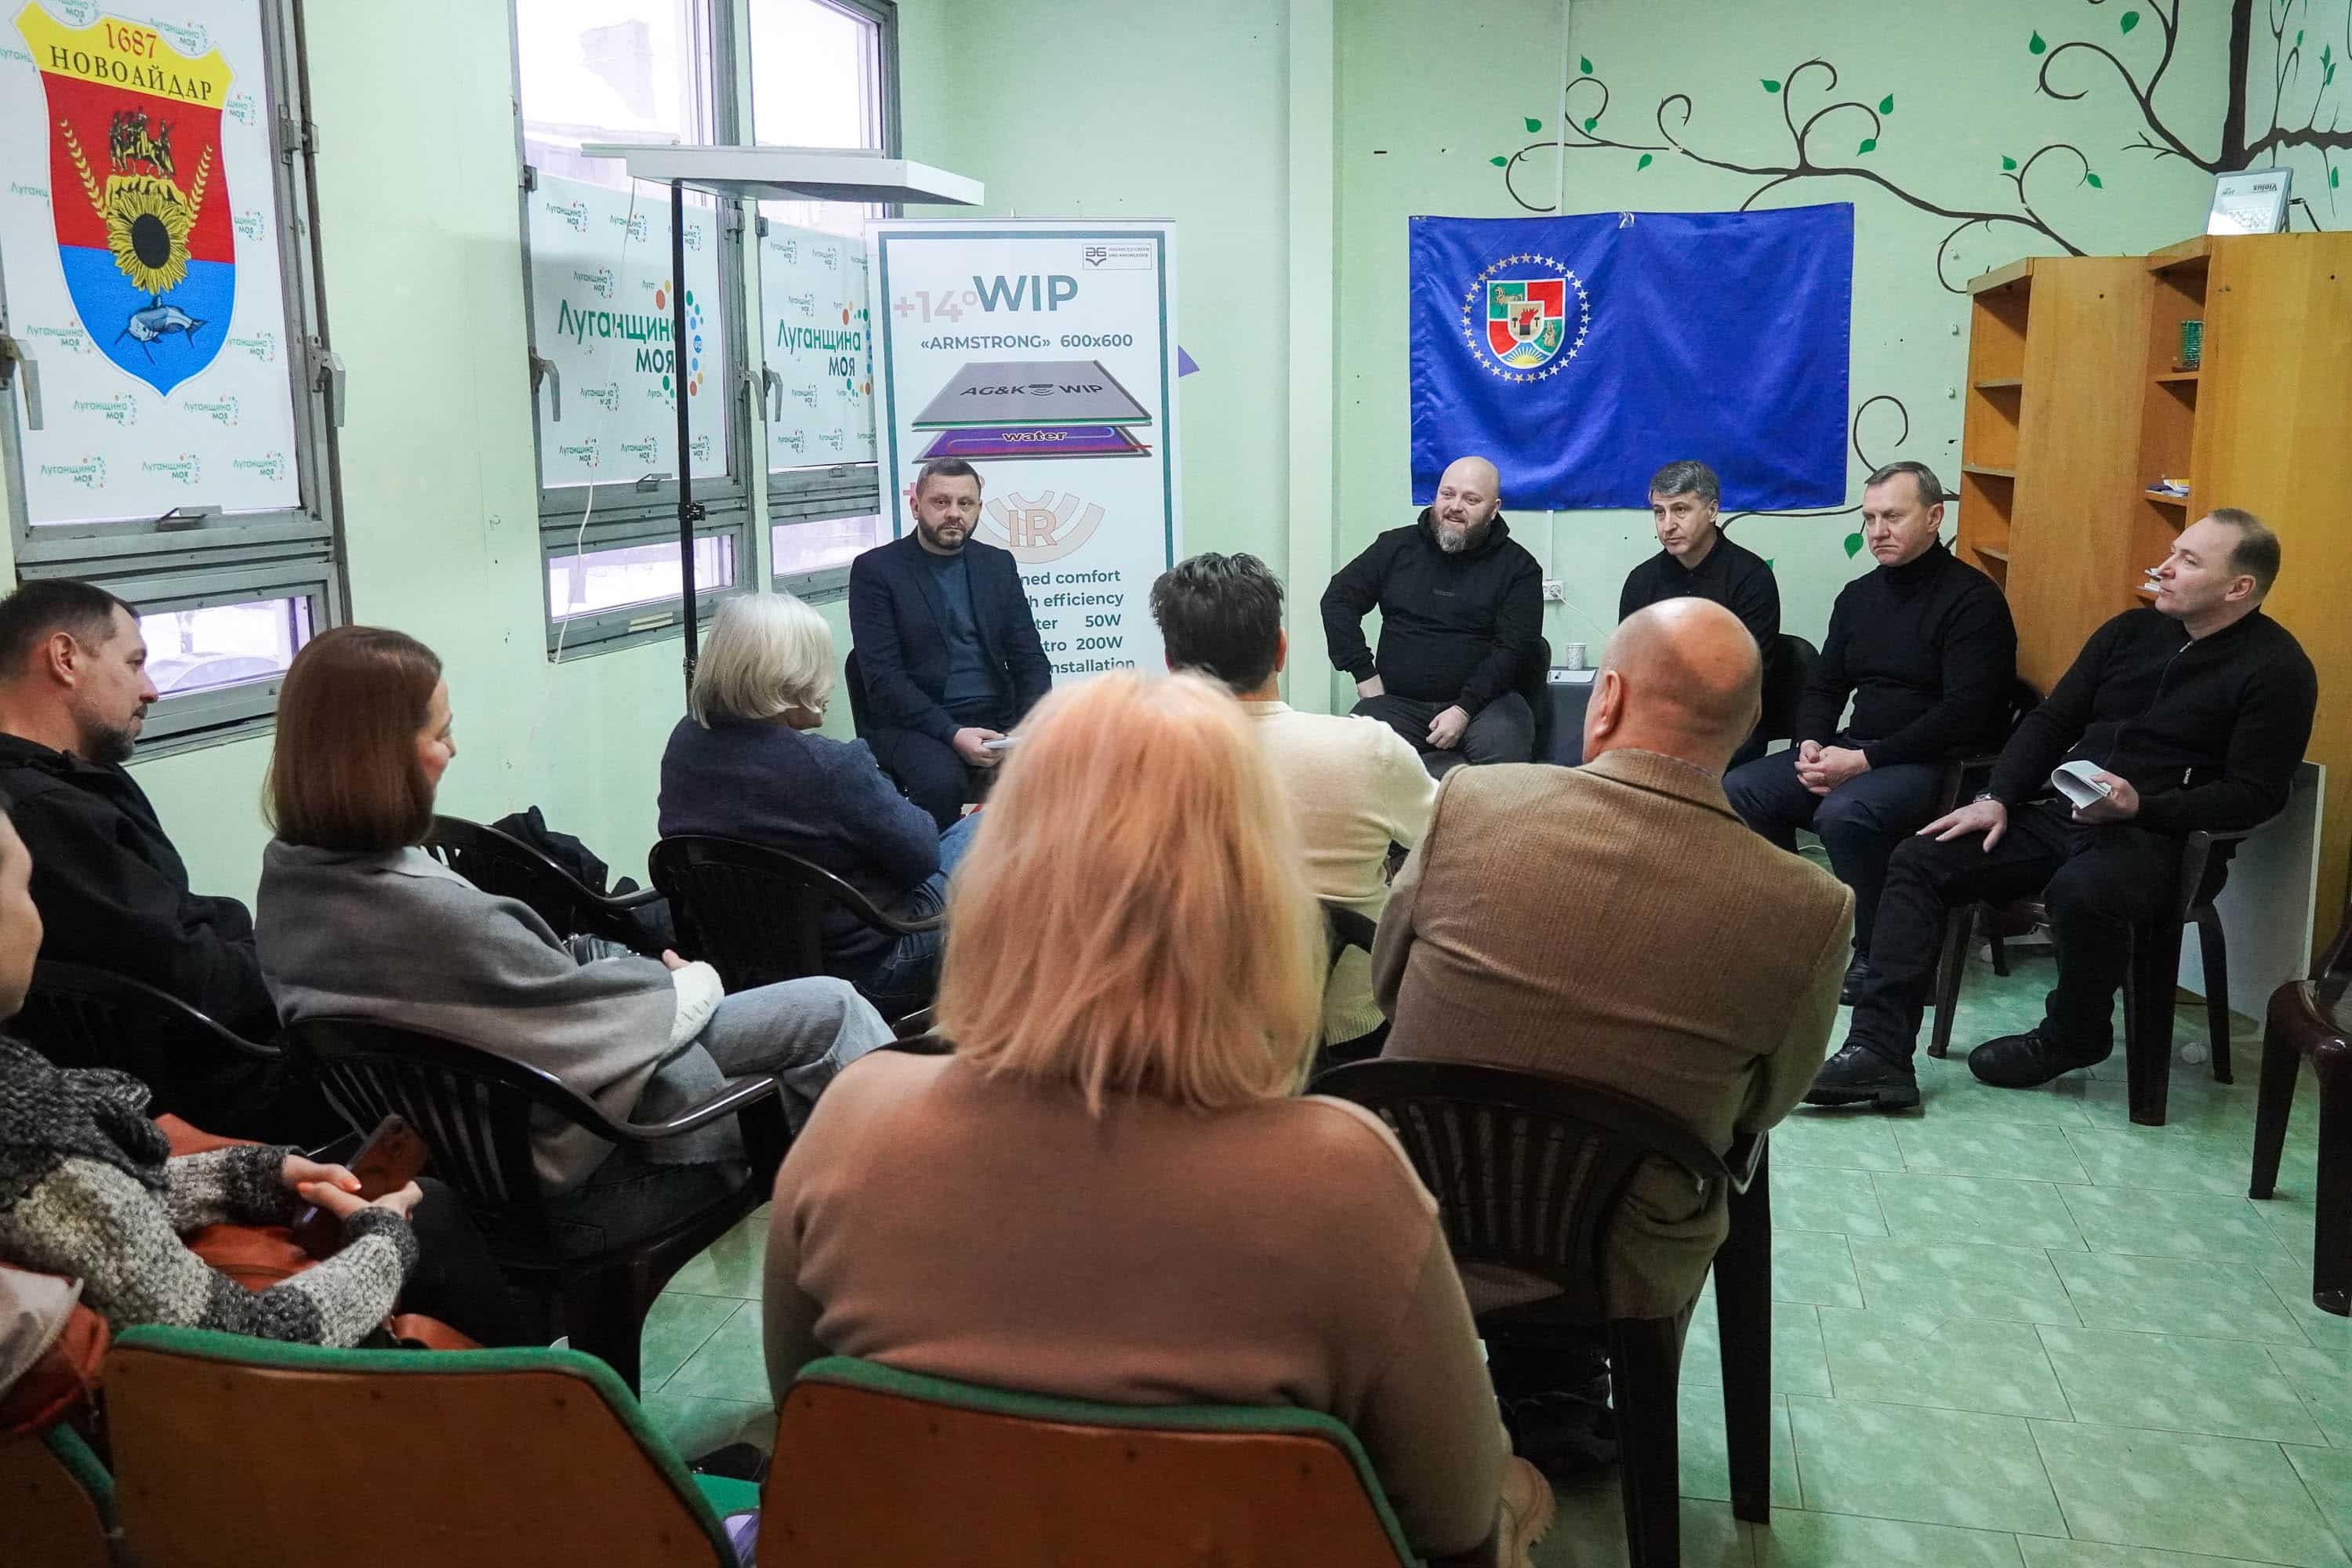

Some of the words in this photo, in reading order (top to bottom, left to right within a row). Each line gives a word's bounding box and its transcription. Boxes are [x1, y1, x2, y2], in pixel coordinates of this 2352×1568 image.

[106, 23, 157, 60] 1687
[50, 45, 212, 101] НОВОАЙДАР
[973, 275, 1079, 312] WIP
[777, 319, 862, 354] Луганщина
[920, 335, 1051, 350] «ARMSTRONG»
[1060, 333, 1134, 348] 600x600
[636, 348, 675, 374] моя
[828, 356, 856, 378] моя
[959, 386, 1025, 396] AG&K
[1059, 384, 1104, 394] WIP
[1002, 431, 1067, 442] water
[1008, 508, 1058, 547] IR
[1021, 572, 1051, 586] ned
[1055, 569, 1121, 584] comfort
[1044, 592, 1124, 607] efficiency
[1035, 619, 1058, 630] ter
[1085, 614, 1122, 628] 50W
[1076, 636, 1123, 651] 200W
[1051, 657, 1135, 674] nstallation
